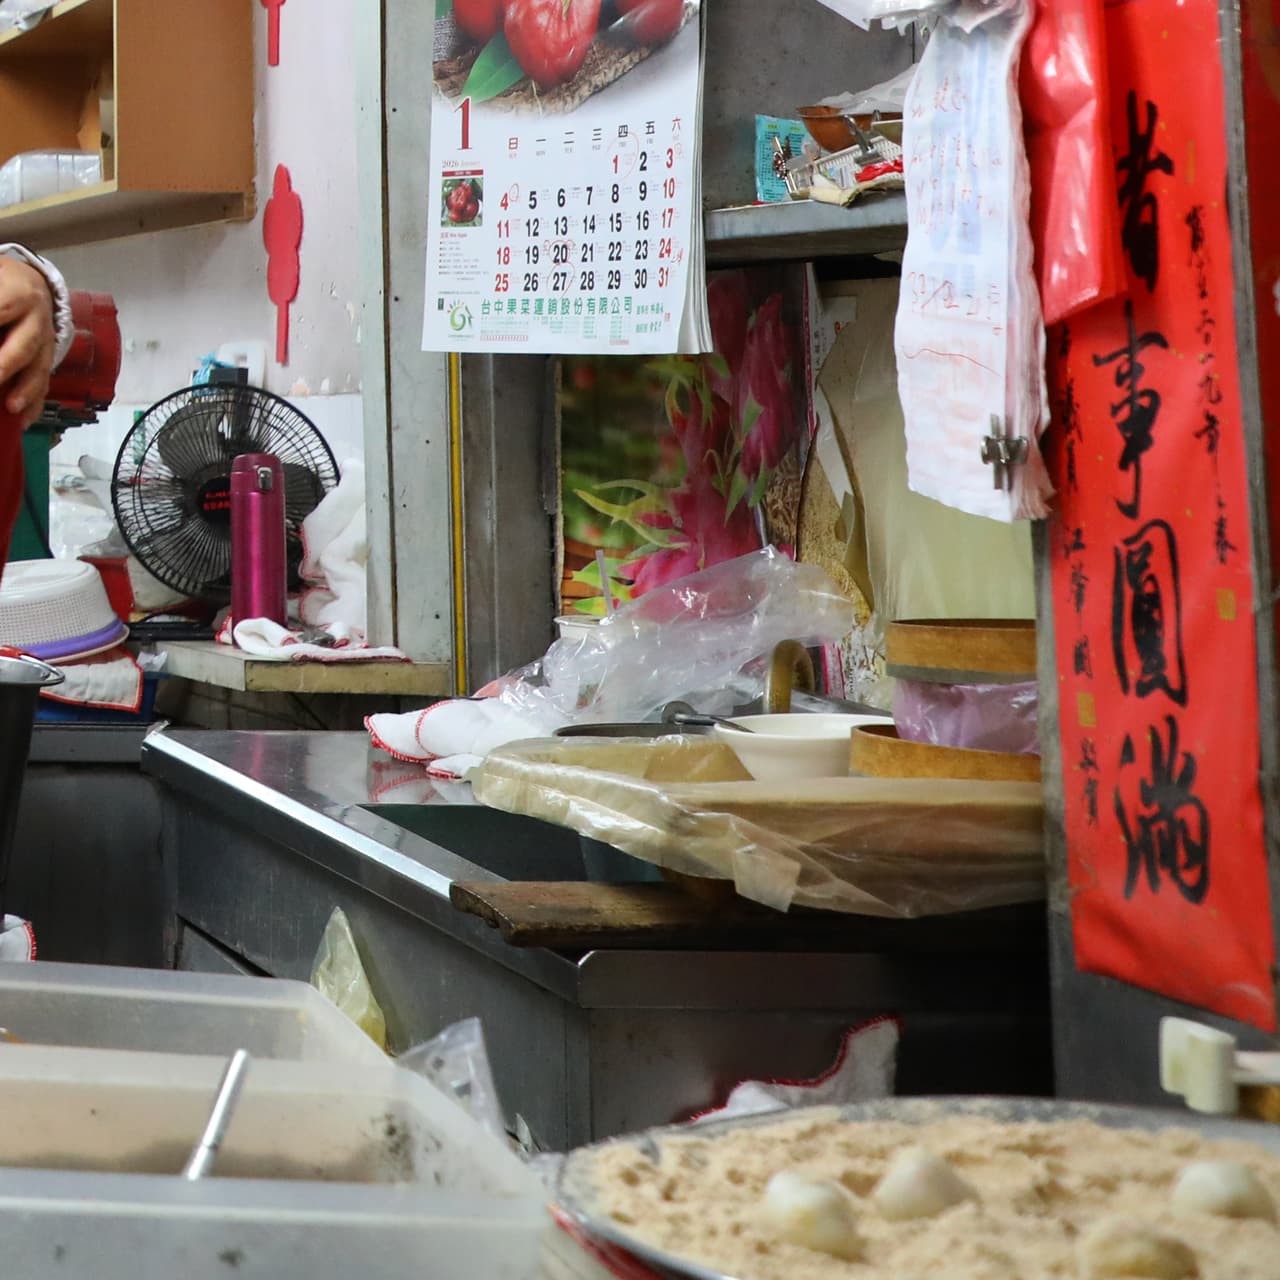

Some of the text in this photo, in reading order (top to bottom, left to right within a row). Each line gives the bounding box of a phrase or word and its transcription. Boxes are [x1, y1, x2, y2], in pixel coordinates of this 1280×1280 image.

[453, 97, 472, 150] 1
[508, 137, 518, 150] 日
[591, 128, 602, 141] 三
[617, 124, 629, 138] 四
[645, 120, 655, 135] 五
[671, 116, 681, 132] 六
[612, 147, 674, 174] 1 2 3
[500, 177, 675, 211] 4 5 6 7 8 9 10
[497, 207, 674, 238] 11 12 13 14 15 16 17
[496, 246, 511, 265] 18
[525, 244, 540, 265] 19
[552, 243, 569, 264] 20
[580, 242, 594, 263] 21
[607, 241, 622, 262] 22
[634, 239, 649, 261] 23
[658, 238, 672, 259] 24
[494, 267, 669, 292] 25 26 27 28 29 30 31
[480, 295, 633, 315] 台中果菜運銷股份有限公司
